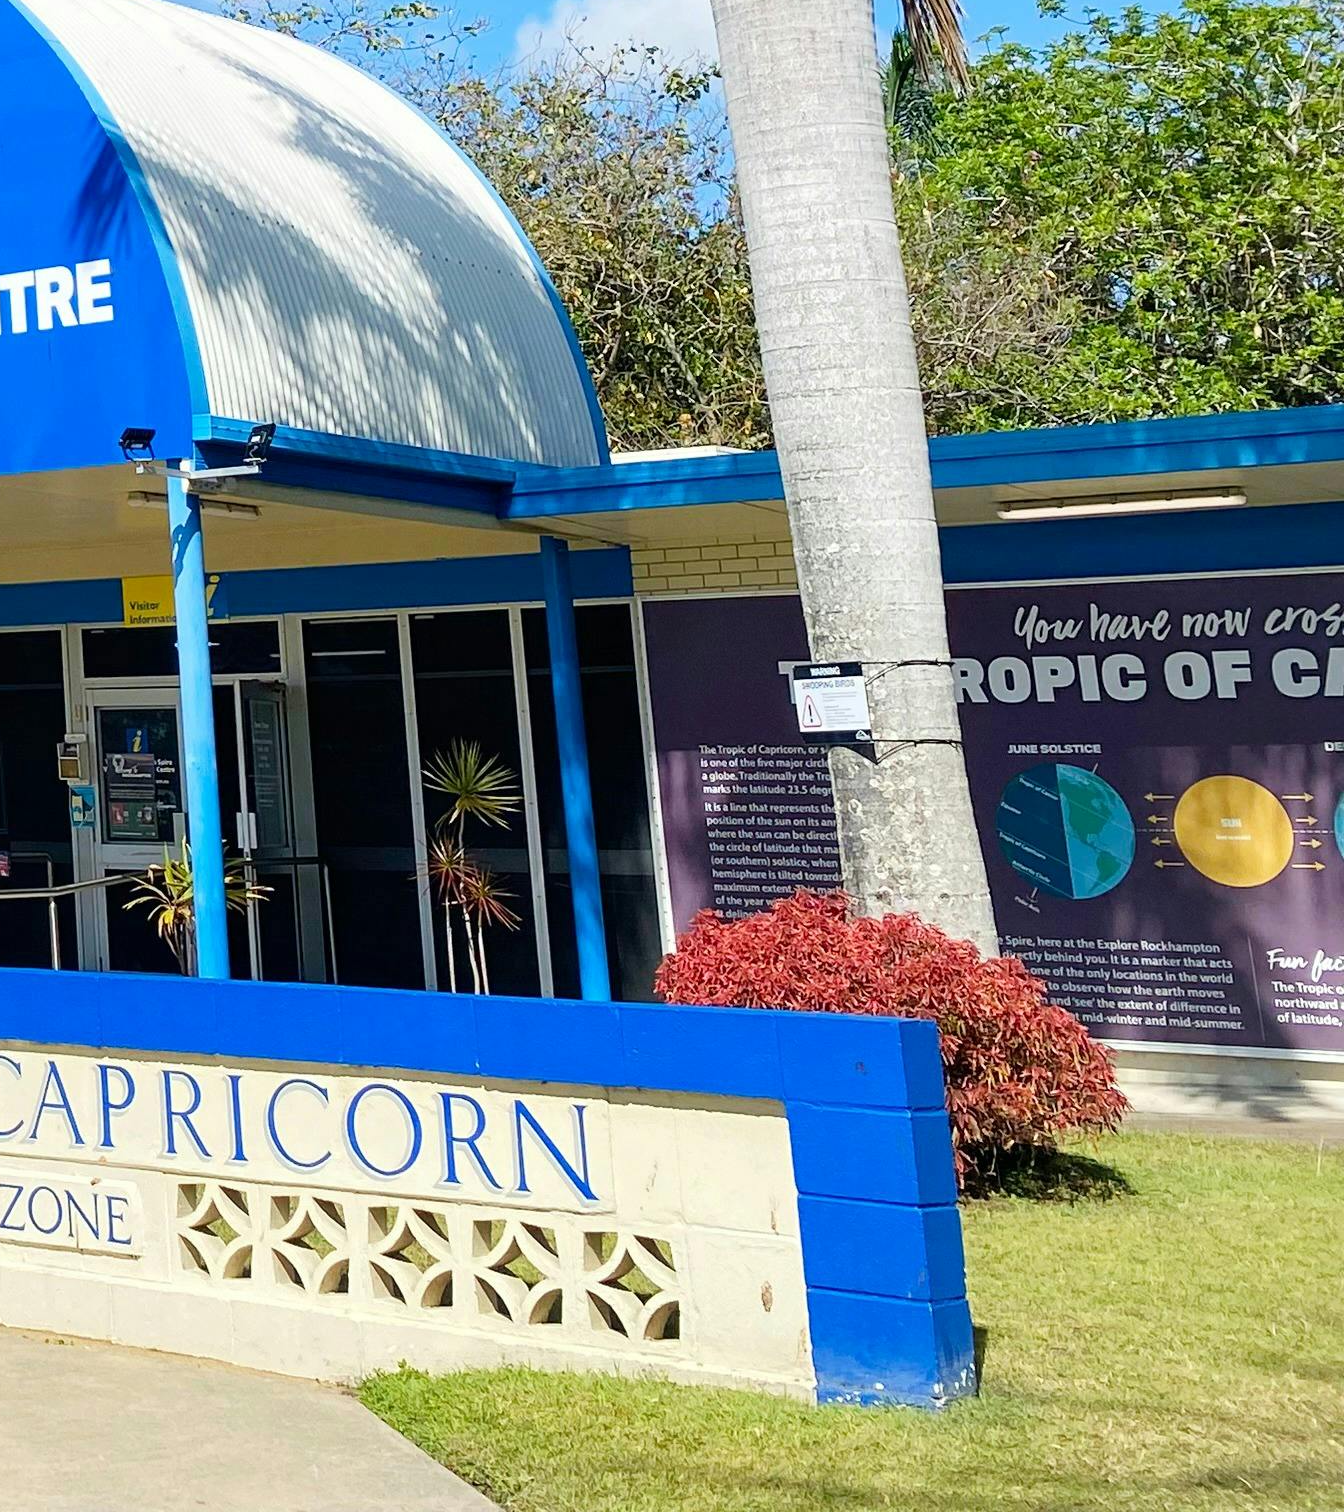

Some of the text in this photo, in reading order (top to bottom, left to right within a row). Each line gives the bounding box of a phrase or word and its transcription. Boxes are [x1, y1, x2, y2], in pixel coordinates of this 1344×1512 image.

[130, 601, 160, 610] Visitor
[1014, 605, 1083, 650] You
[1090, 603, 1172, 642] have
[1182, 607, 1251, 638] now
[953, 654, 1147, 704] ROPIC
[1163, 650, 1252, 700] OF
[700, 745, 716, 754] The
[718, 745, 744, 756] Tropic
[747, 745, 757, 754] of
[758, 745, 806, 756] Capricorn,
[1008, 744, 1101, 754] JUNE SOLSTICE
[701, 759, 708, 767] is
[729, 758, 738, 768] of
[740, 758, 755, 768] the
[757, 758, 774, 768] five
[776, 759, 803, 770] major
[710, 771, 739, 782] globe.
[739, 772, 796, 783] Traditionally
[798, 772, 814, 781] the
[703, 785, 731, 794] marks
[733, 786, 747, 794] the
[750, 785, 785, 794] latitude
[788, 786, 808, 794] 23.5
[705, 802, 712, 811] It
[714, 803, 721, 811] is
[730, 803, 747, 812] line
[749, 803, 768, 812] that
[770, 804, 819, 815] represents
[706, 816, 744, 827] position
[746, 816, 755, 825] of
[757, 817, 772, 825] the
[793, 819, 806, 827] on
[808, 817, 819, 827] its
[708, 830, 736, 838] where
[738, 830, 753, 838] the
[792, 830, 805, 840] be
[710, 843, 724, 851] the
[726, 843, 750, 851] circle
[752, 843, 762, 852] of
[764, 843, 800, 853] latitude
[802, 844, 822, 854] that
[712, 856, 838, 868] (or southern) solstice, when
[712, 869, 802, 880] hemisphere is tilted
[714, 883, 794, 893] maximum extent.
[716, 896, 725, 905] of
[727, 896, 742, 905] the
[744, 898, 763, 907] year
[1005, 936, 1036, 947] Spire,
[1037, 938, 1062, 948] here
[1063, 939, 1075, 948] at
[1077, 939, 1095, 949] the
[1097, 940, 1139, 951] Explore
[1141, 941, 1220, 954] Rockhampton
[1045, 951, 1232, 969] behind you. It is a marker that acts
[1266, 948, 1308, 969] Fun
[1030, 967, 1233, 984] one of the only locations in the world
[1048, 981, 1225, 999] to observe how the earth moves
[1272, 981, 1335, 996] The Tropic
[1050, 996, 1070, 1007] and
[1097, 997, 1115, 1008] the
[1117, 999, 1154, 1010] extent
[1156, 999, 1168, 1011] of
[1170, 1001, 1227, 1014] difference
[1229, 1003, 1241, 1014] in
[1275, 998, 1338, 1010] northward
[1082, 1013, 1143, 1025] mid-winter
[1145, 1015, 1166, 1026] and
[1169, 1016, 1245, 1030] mid-summer.
[1277, 1012, 1342, 1027] of latitude,
